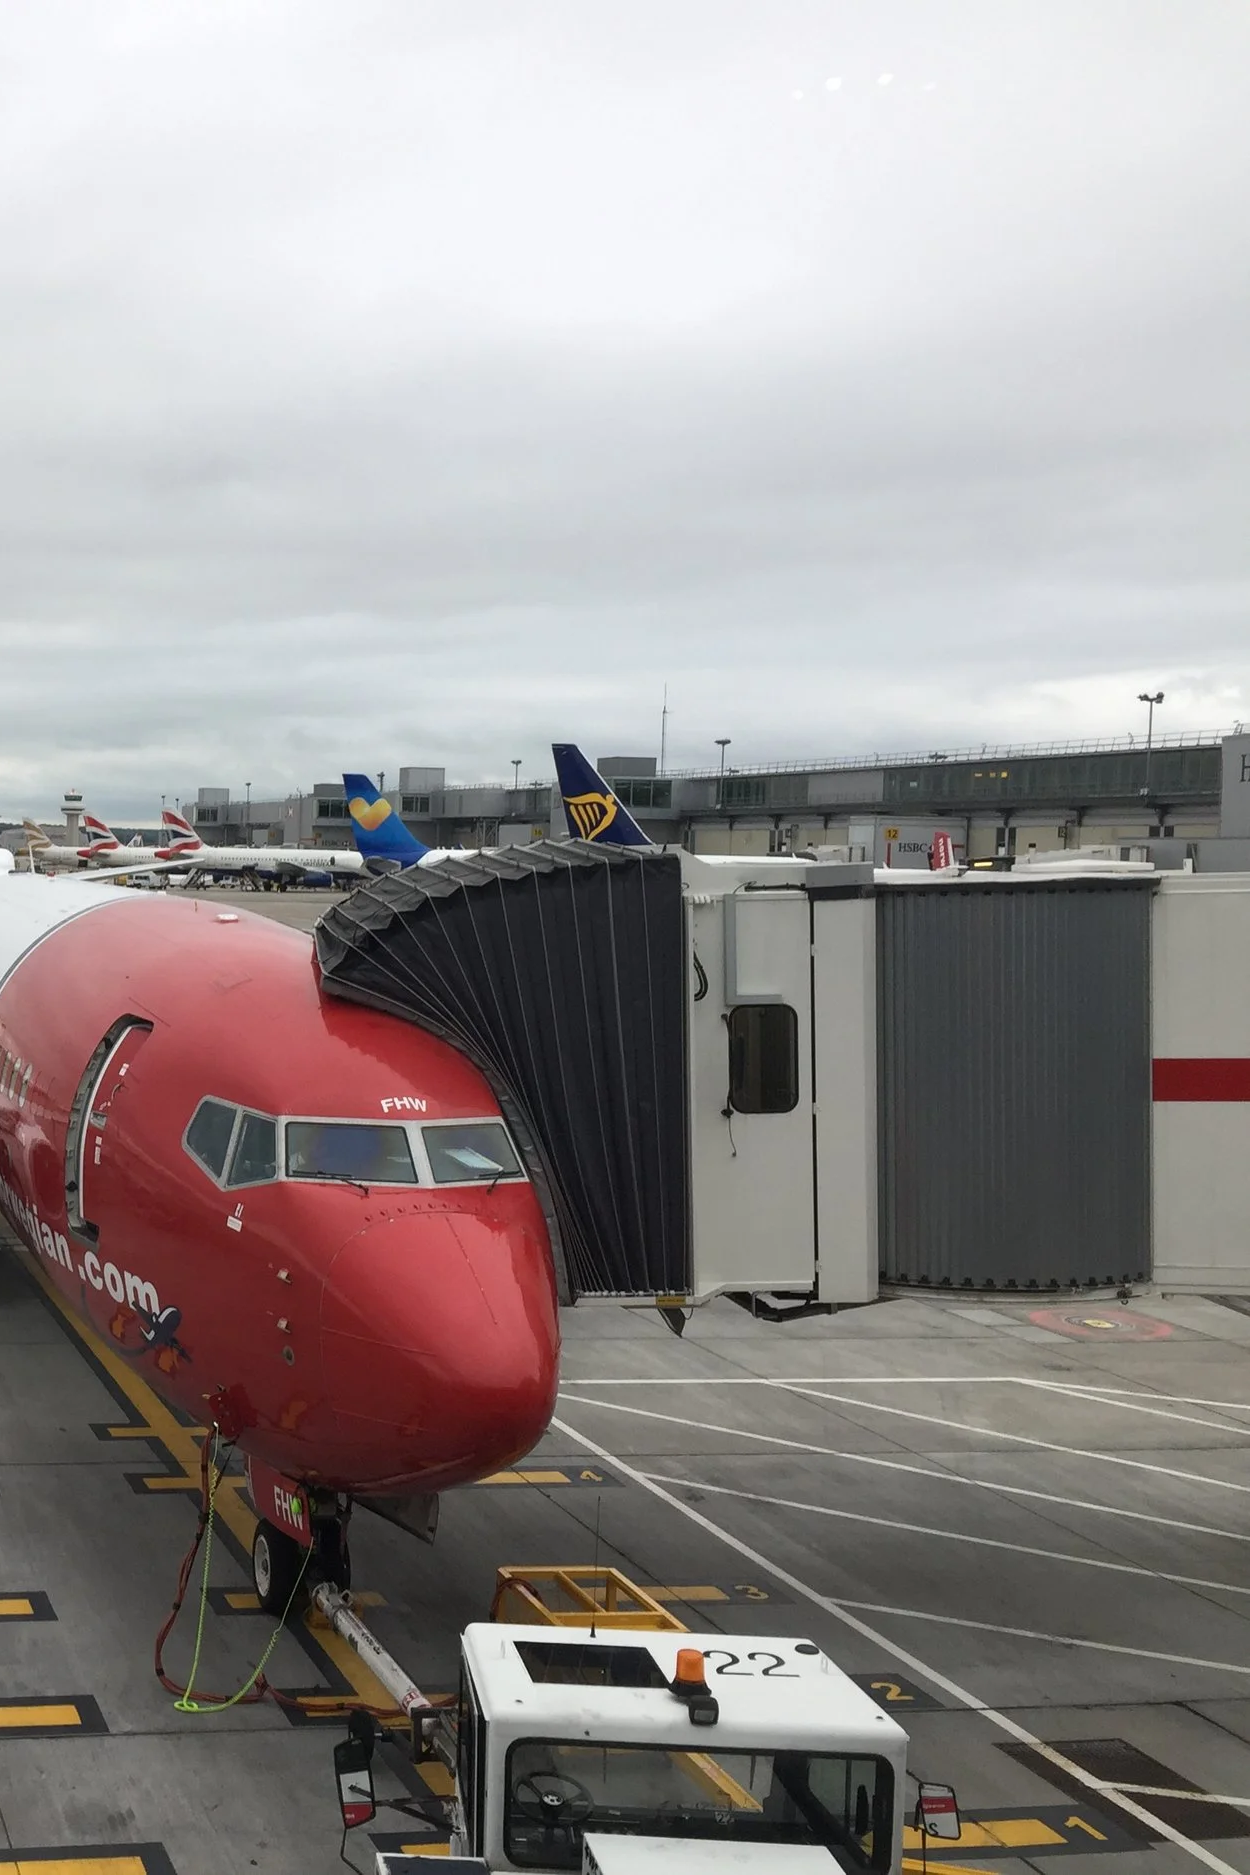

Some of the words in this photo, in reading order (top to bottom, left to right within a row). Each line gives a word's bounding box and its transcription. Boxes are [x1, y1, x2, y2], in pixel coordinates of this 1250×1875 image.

[888, 829, 898, 838] 12
[898, 842, 928, 853] HSBC
[380, 1096, 427, 1113] FHW
[78, 1250, 160, 1317] .com
[273, 1484, 303, 1531] FHW
[734, 1585, 770, 1600] 3
[703, 1650, 800, 1678] 22
[870, 1682, 915, 1701] 2
[1064, 1816, 1108, 1840] 1
